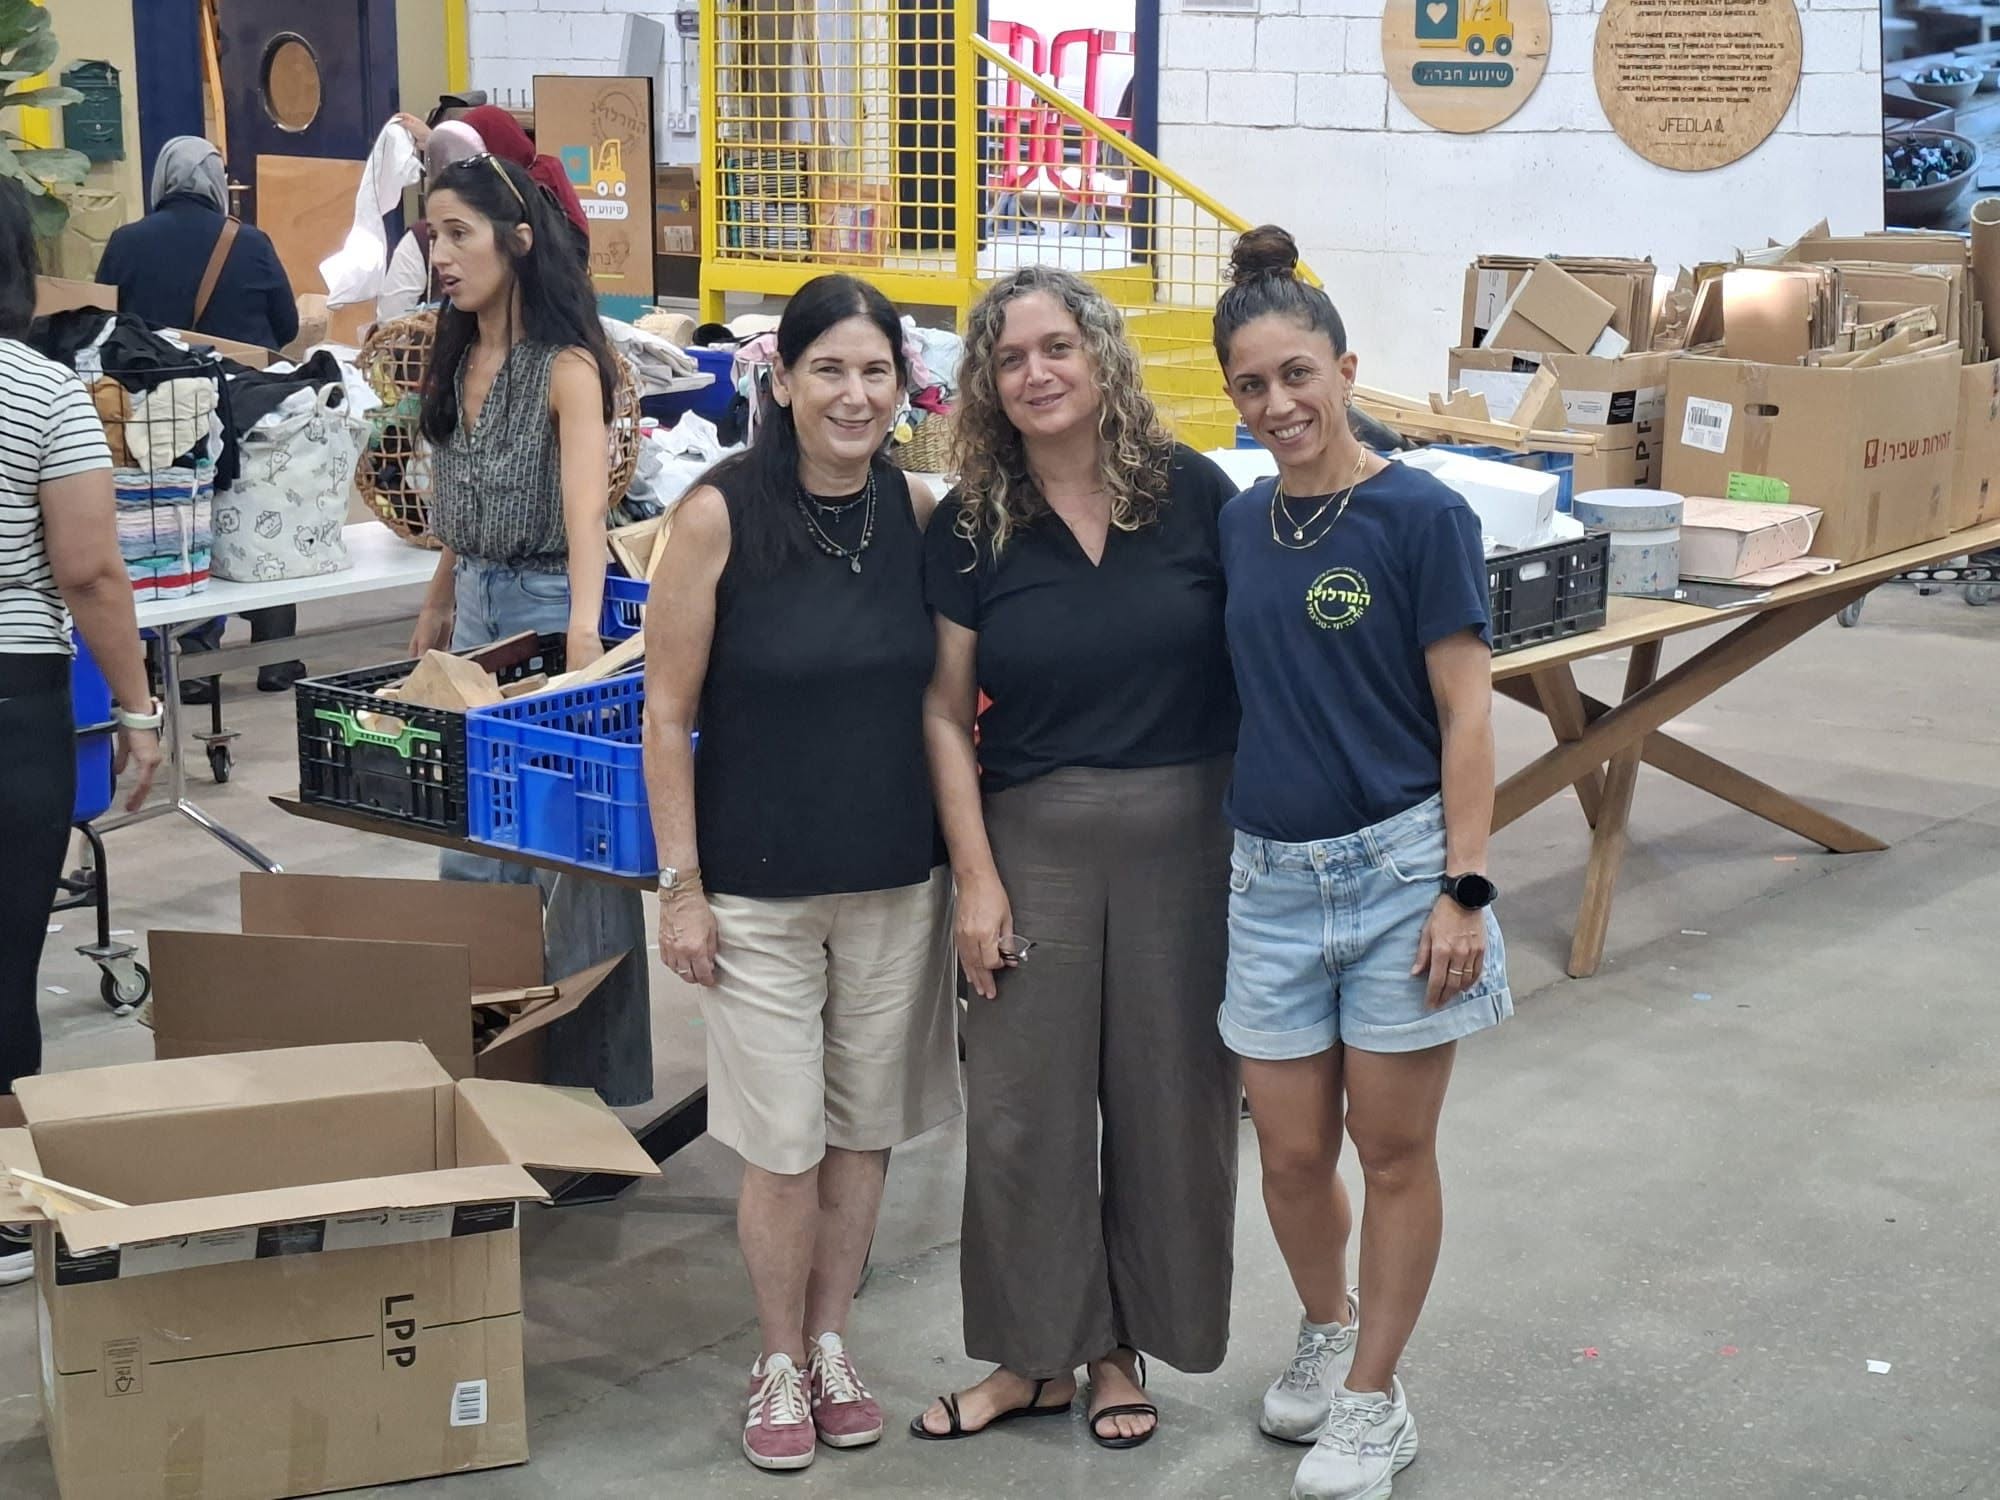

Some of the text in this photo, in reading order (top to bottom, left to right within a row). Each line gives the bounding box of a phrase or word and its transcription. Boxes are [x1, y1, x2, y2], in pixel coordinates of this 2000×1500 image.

[1468, 69, 1508, 82] שינוע
[1658, 117, 1713, 133] JFEDLA
[599, 204, 625, 216] שינוע
[1881, 429, 1952, 464] זהירות שביר!
[384, 1293, 417, 1368] LPP
